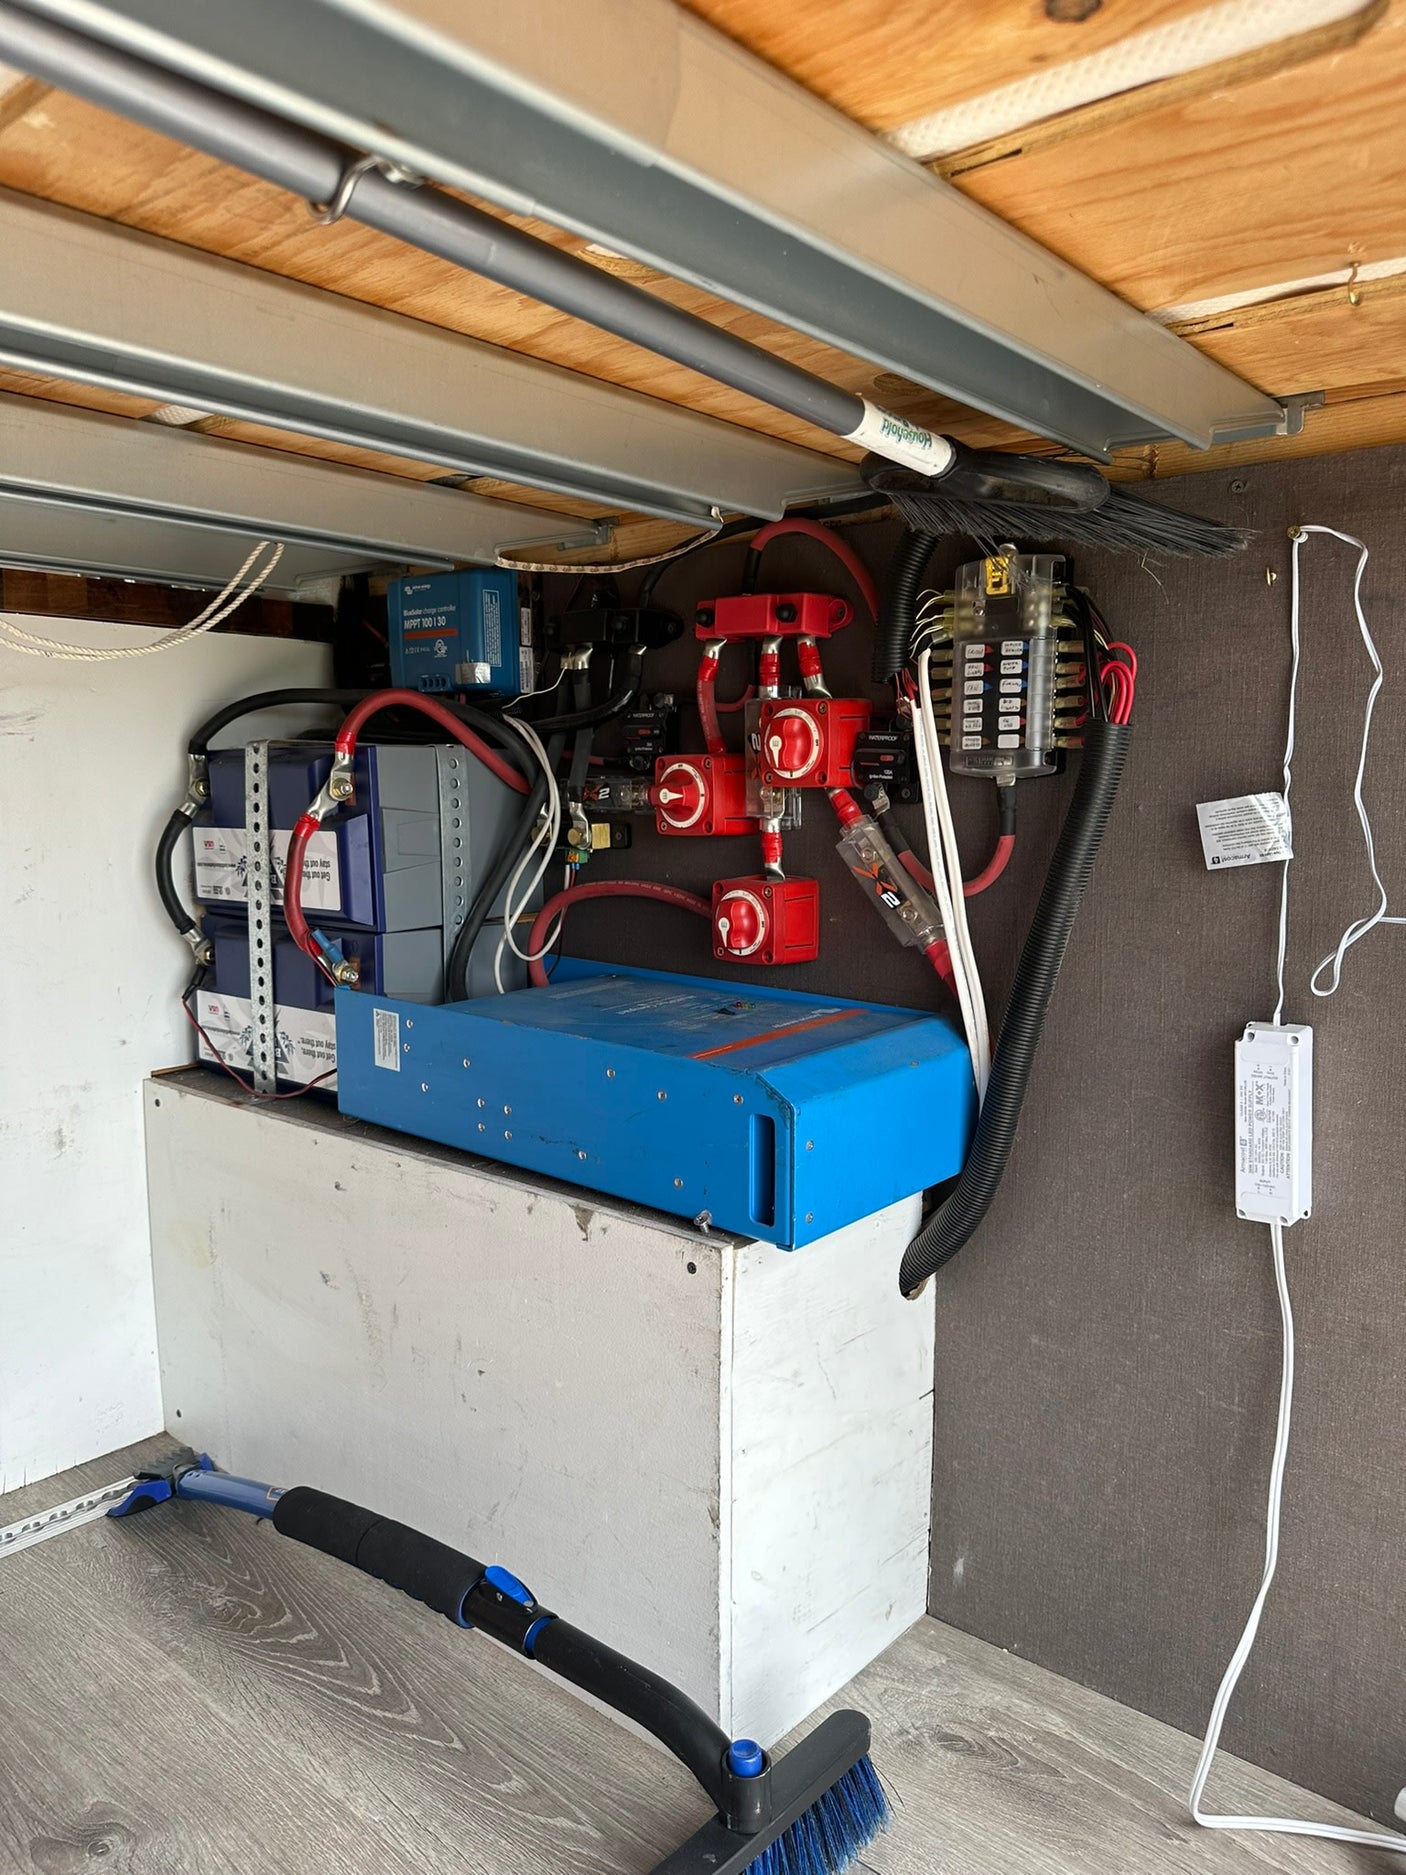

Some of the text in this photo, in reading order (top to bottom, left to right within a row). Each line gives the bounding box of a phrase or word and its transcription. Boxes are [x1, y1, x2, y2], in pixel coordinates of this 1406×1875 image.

[881, 417, 933, 449] Household
[403, 618, 421, 630] MPPT
[421, 617, 433, 628] 100
[437, 615, 447, 627] 30
[310, 859, 319, 868] out
[1221, 852, 1251, 864] Armacost
[311, 870, 321, 879] out
[321, 870, 331, 882] Get
[315, 1039, 325, 1048] out
[316, 1050, 326, 1060] out
[325, 1052, 336, 1064] Get
[1240, 1147, 1248, 1174] Armacost
